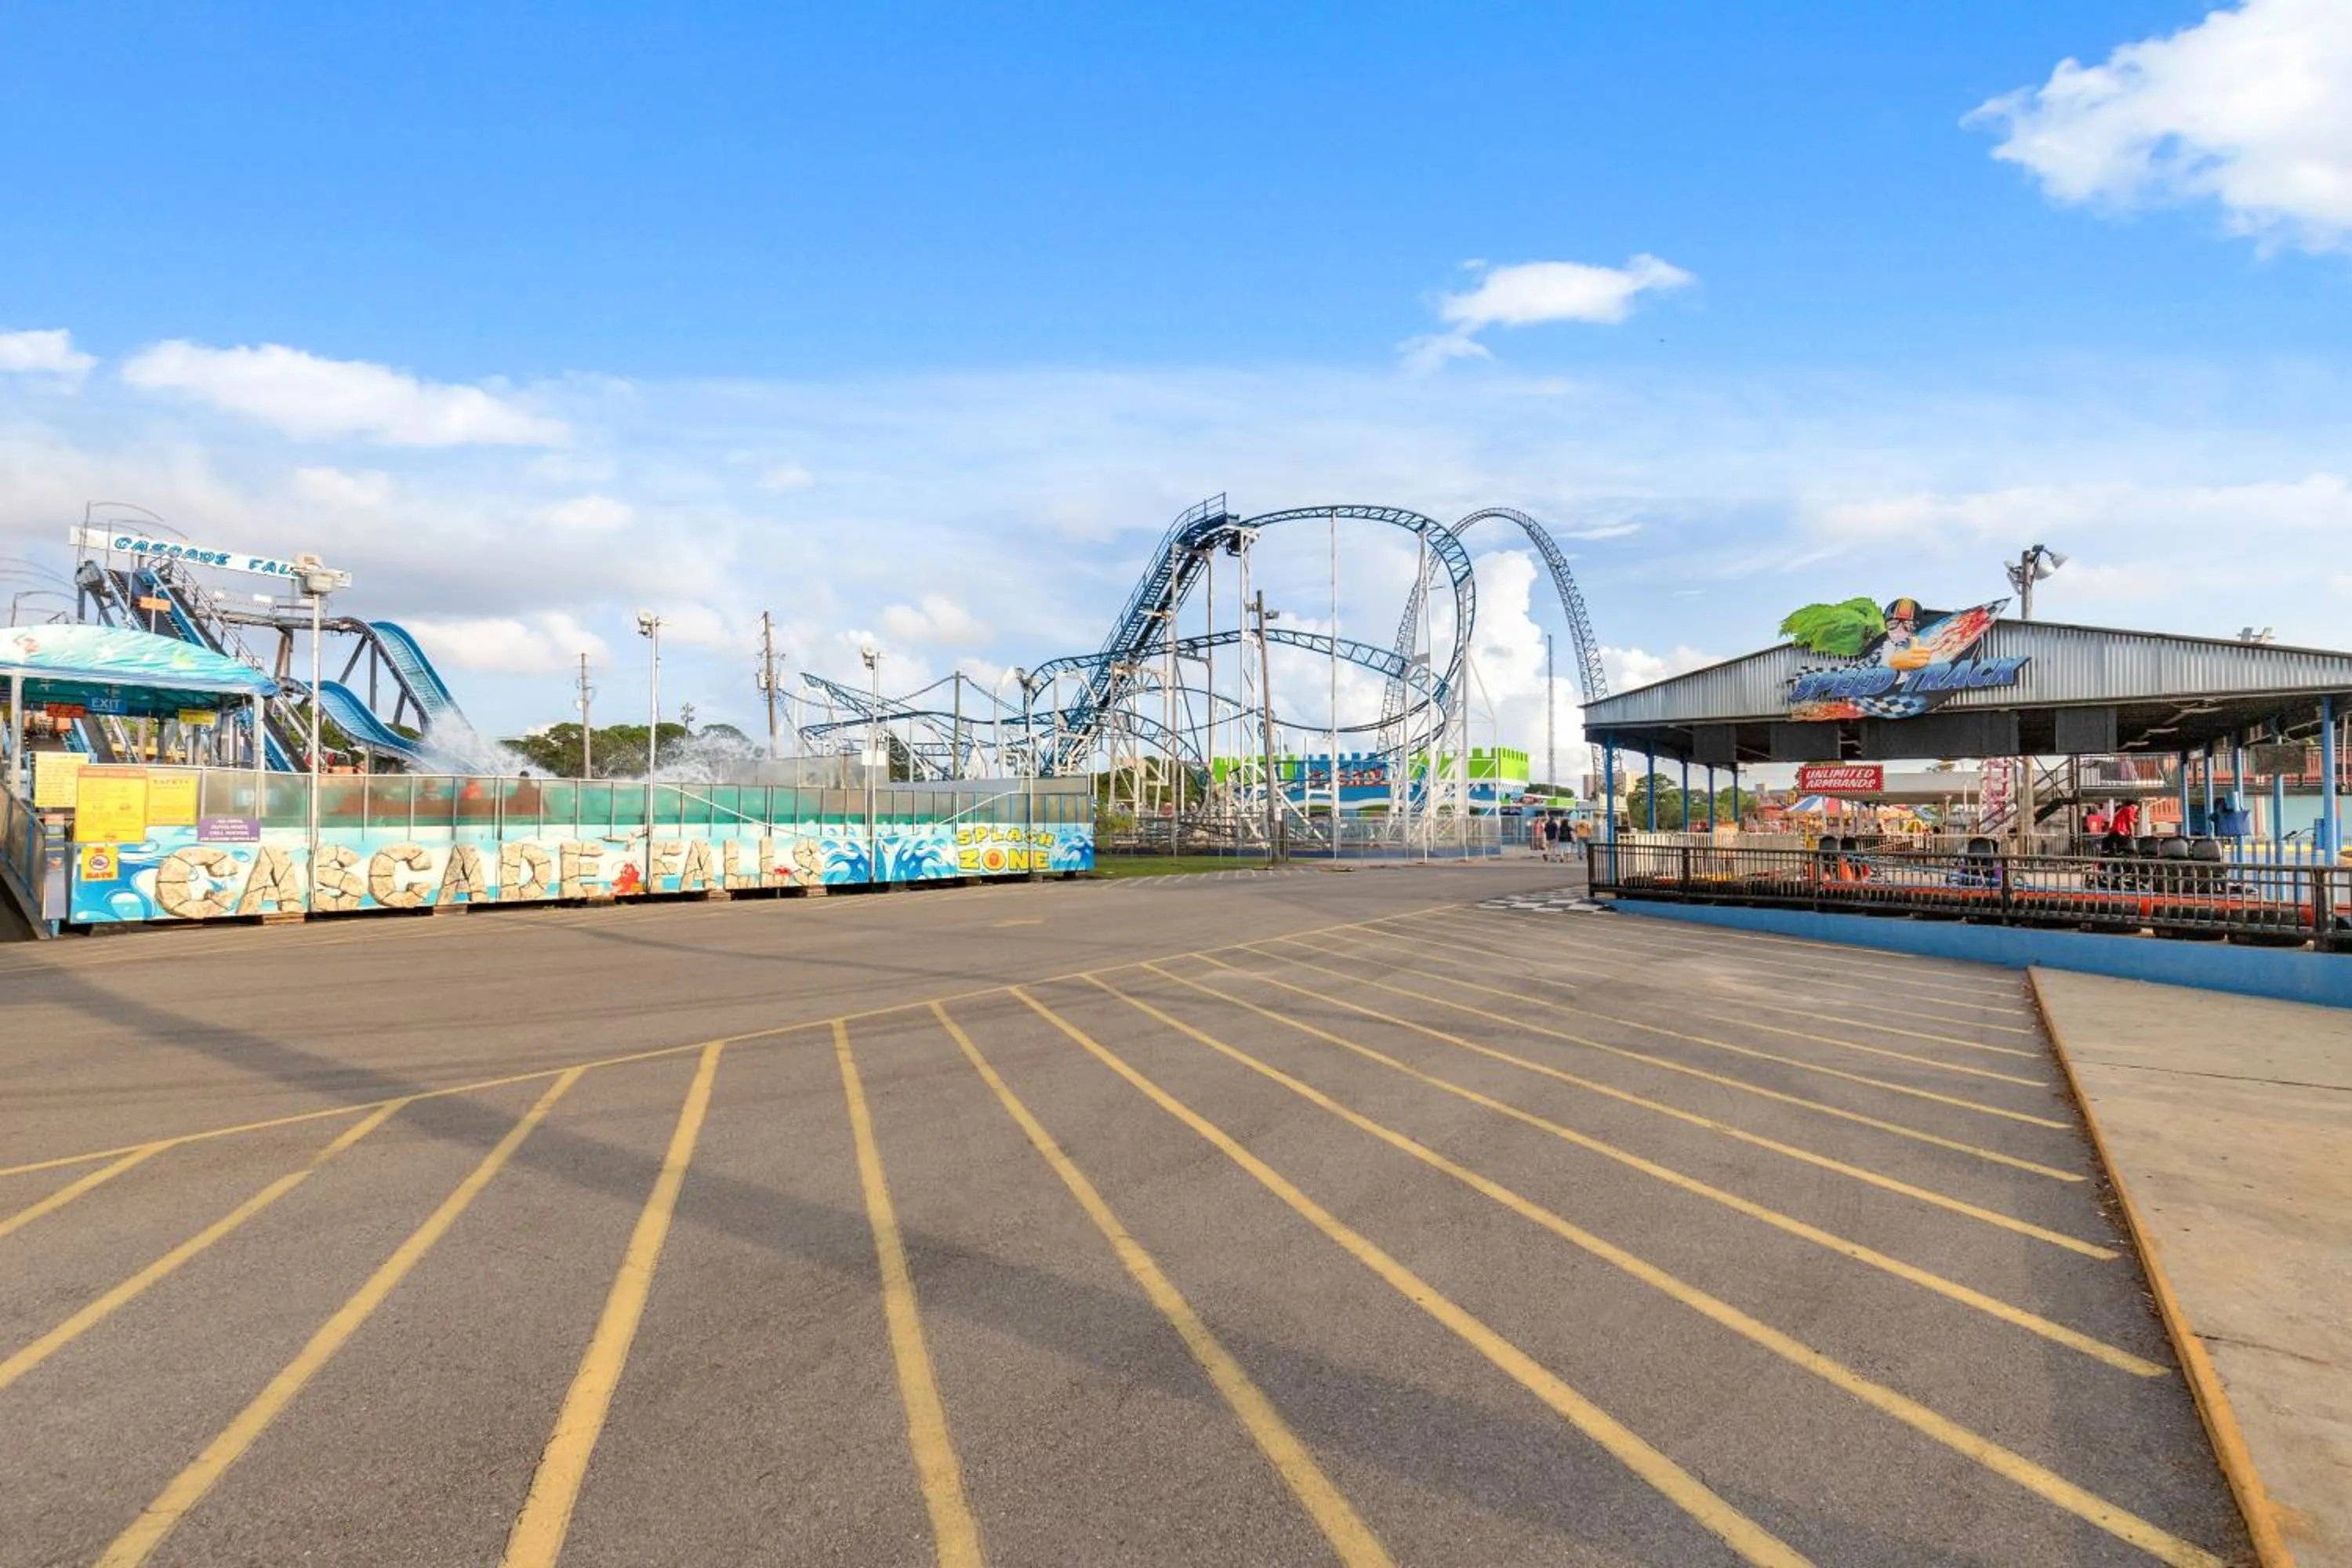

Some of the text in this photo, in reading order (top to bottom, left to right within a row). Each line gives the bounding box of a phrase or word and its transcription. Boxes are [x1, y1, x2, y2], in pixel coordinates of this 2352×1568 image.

[114, 537, 230, 565] CASCADE
[1788, 656, 2031, 702] SPEED TRACK
[91, 698, 121, 709] EXIT
[1805, 779, 1876, 789] ARMBANDS
[1806, 769, 1875, 779] UNLIMITED
[958, 848, 1050, 871] ZONE
[156, 837, 825, 919] CASCADE FALLS
